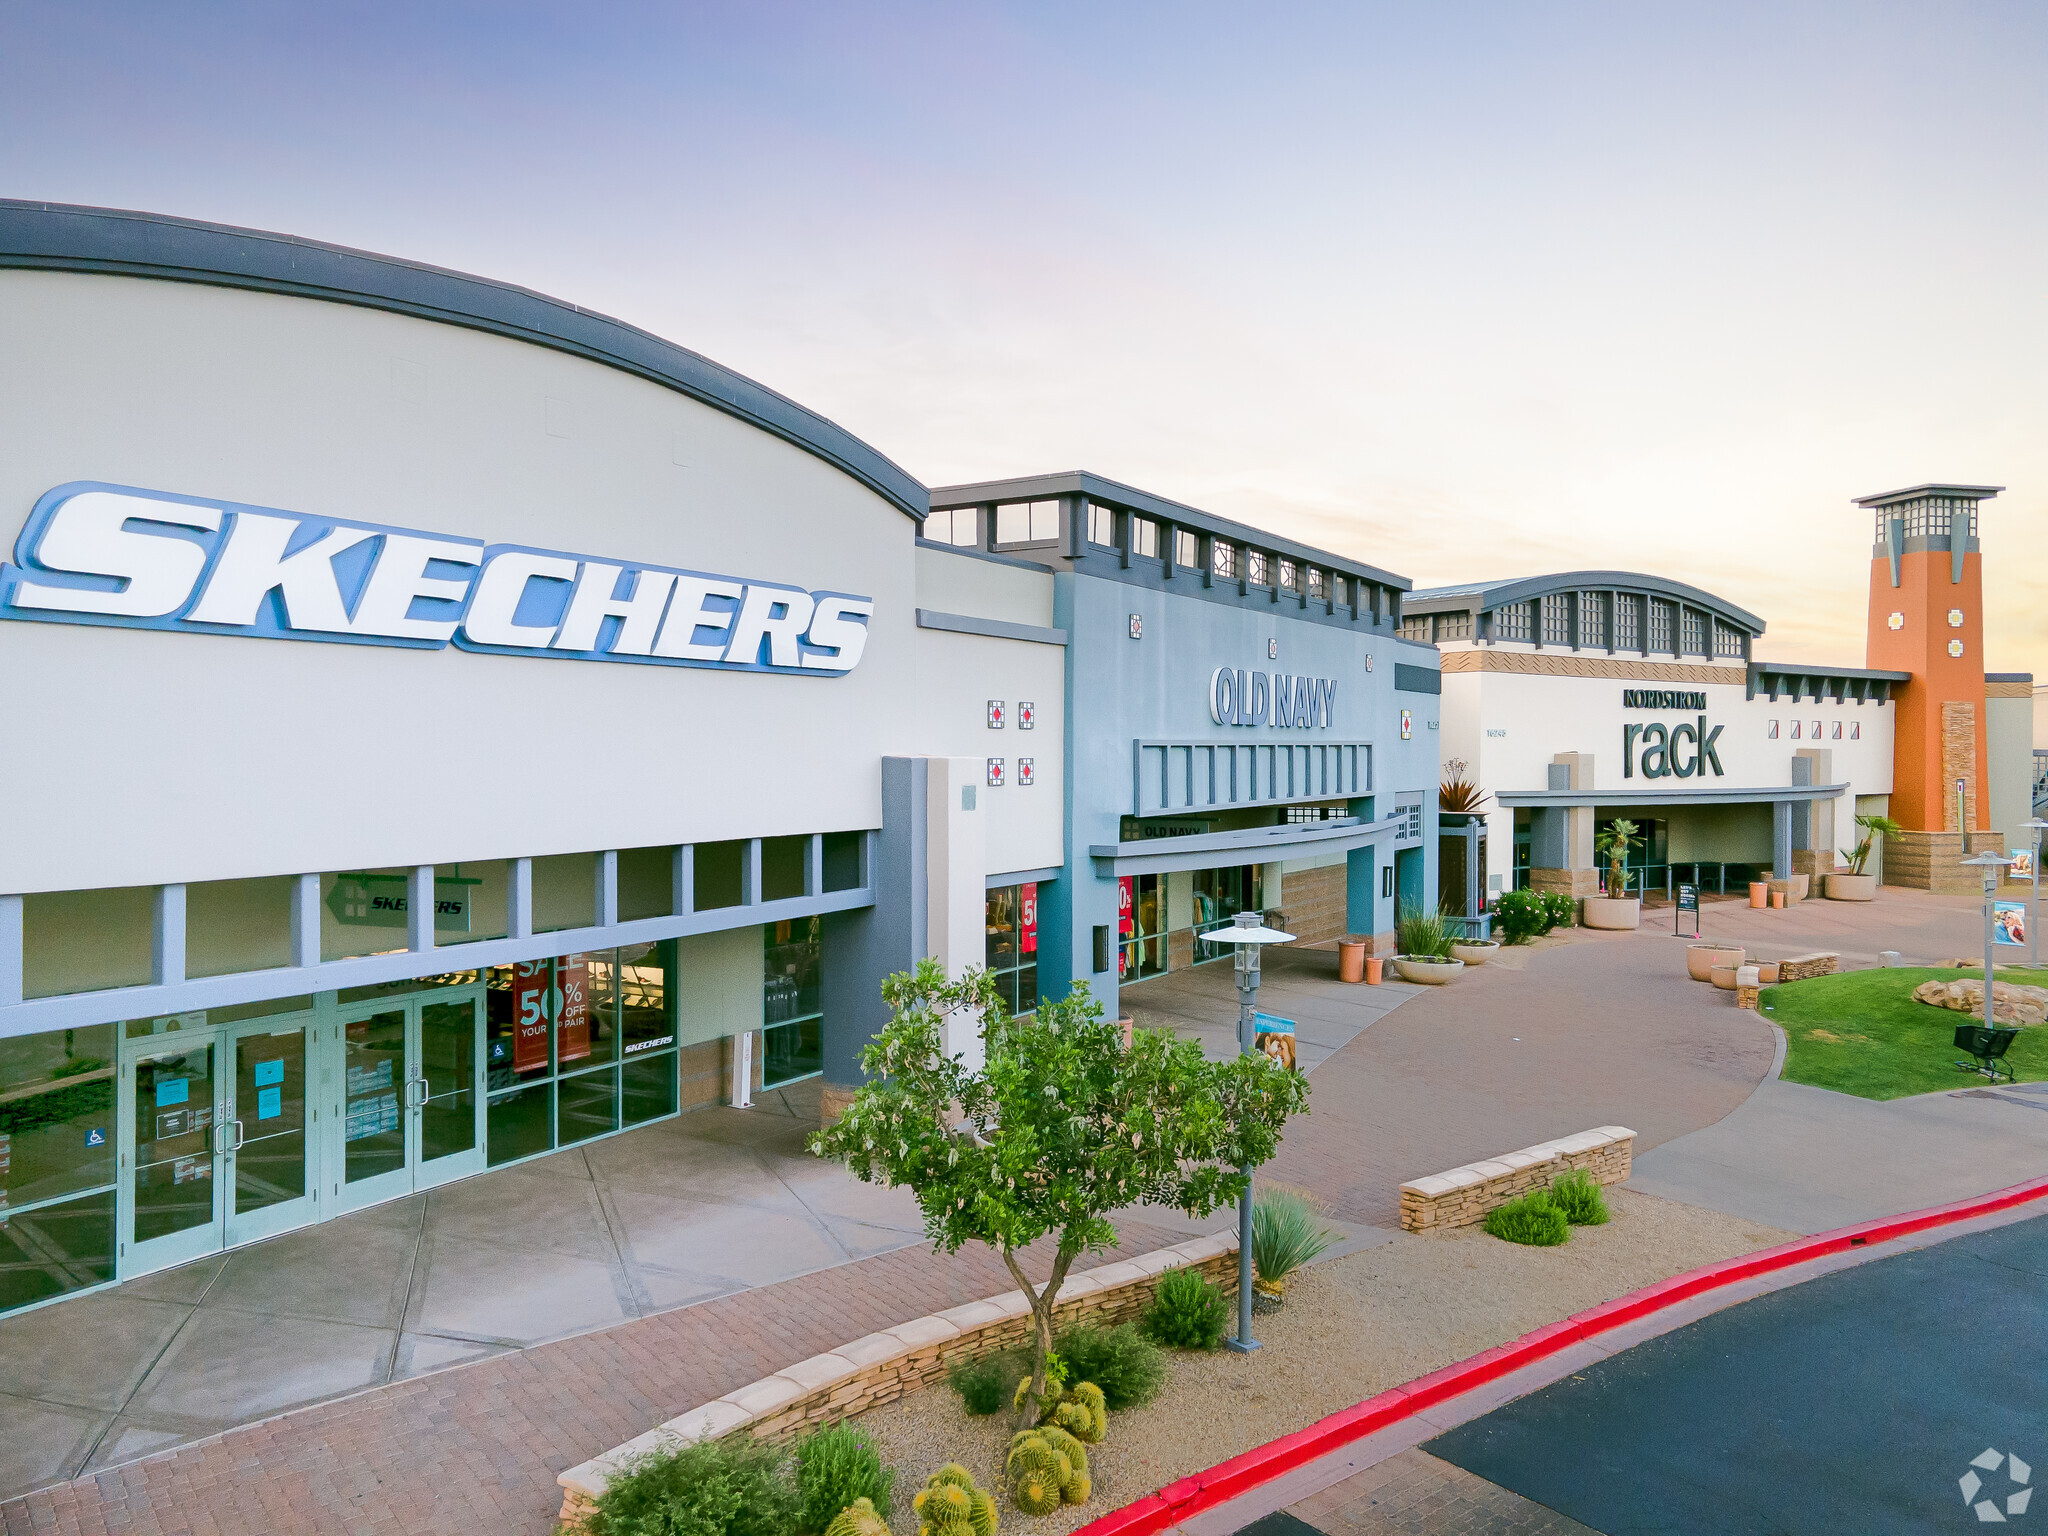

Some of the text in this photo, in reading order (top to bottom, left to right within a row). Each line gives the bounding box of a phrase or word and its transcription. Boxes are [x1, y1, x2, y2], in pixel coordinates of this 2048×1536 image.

[14, 489, 874, 672] SKECHERS
[1209, 667, 1338, 728] OLD NAVY
[1623, 689, 1707, 710] NORDSTROM
[1623, 715, 1725, 779] rack
[1145, 826, 1200, 837] OLD NAVY
[371, 896, 463, 915] SKERS
[565, 1004, 586, 1018] OFF
[521, 1024, 547, 1038] YOUR
[564, 1016, 585, 1029] PAIR
[624, 1035, 674, 1054] SKECHERS
